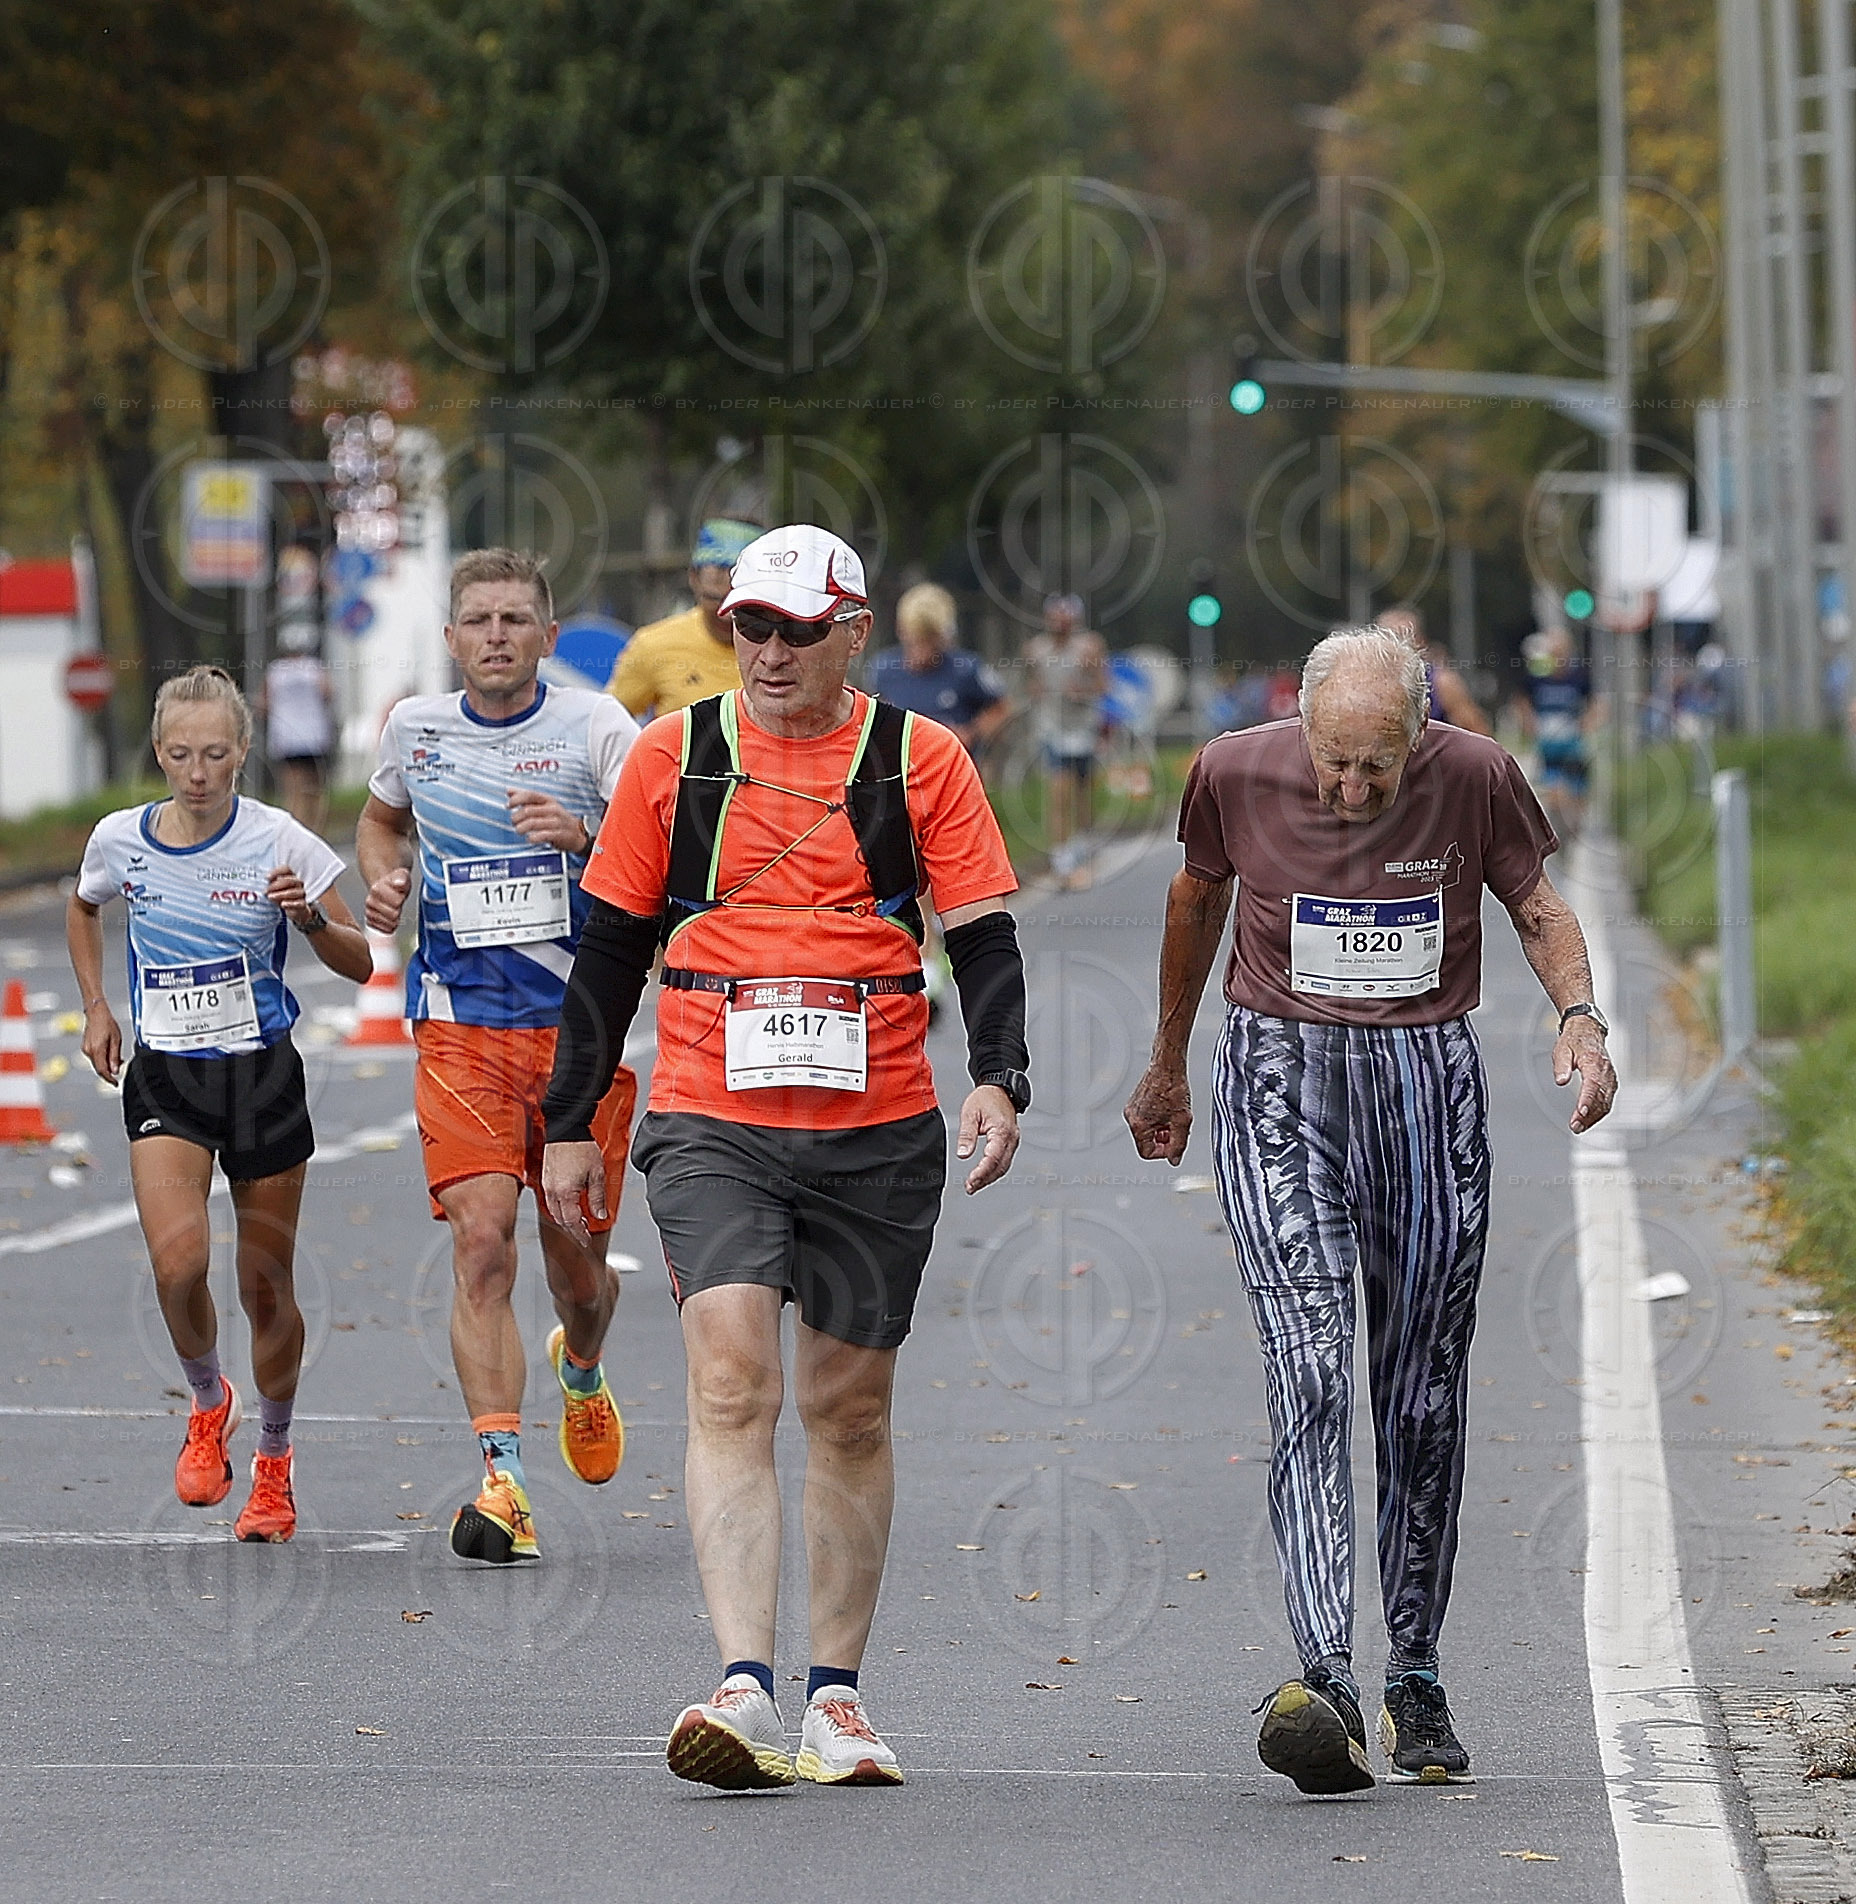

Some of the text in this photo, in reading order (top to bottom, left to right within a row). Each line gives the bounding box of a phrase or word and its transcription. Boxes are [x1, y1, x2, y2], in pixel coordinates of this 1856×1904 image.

[1405, 859, 1439, 871] GRAZ
[481, 883, 531, 905] 1177
[1325, 914, 1376, 923] MARATHON
[1336, 931, 1403, 953] 1820
[169, 990, 219, 1012] 1178
[753, 994, 803, 1005] MARATHON
[763, 1013, 828, 1036] 4617
[779, 1054, 813, 1063] Gerald
